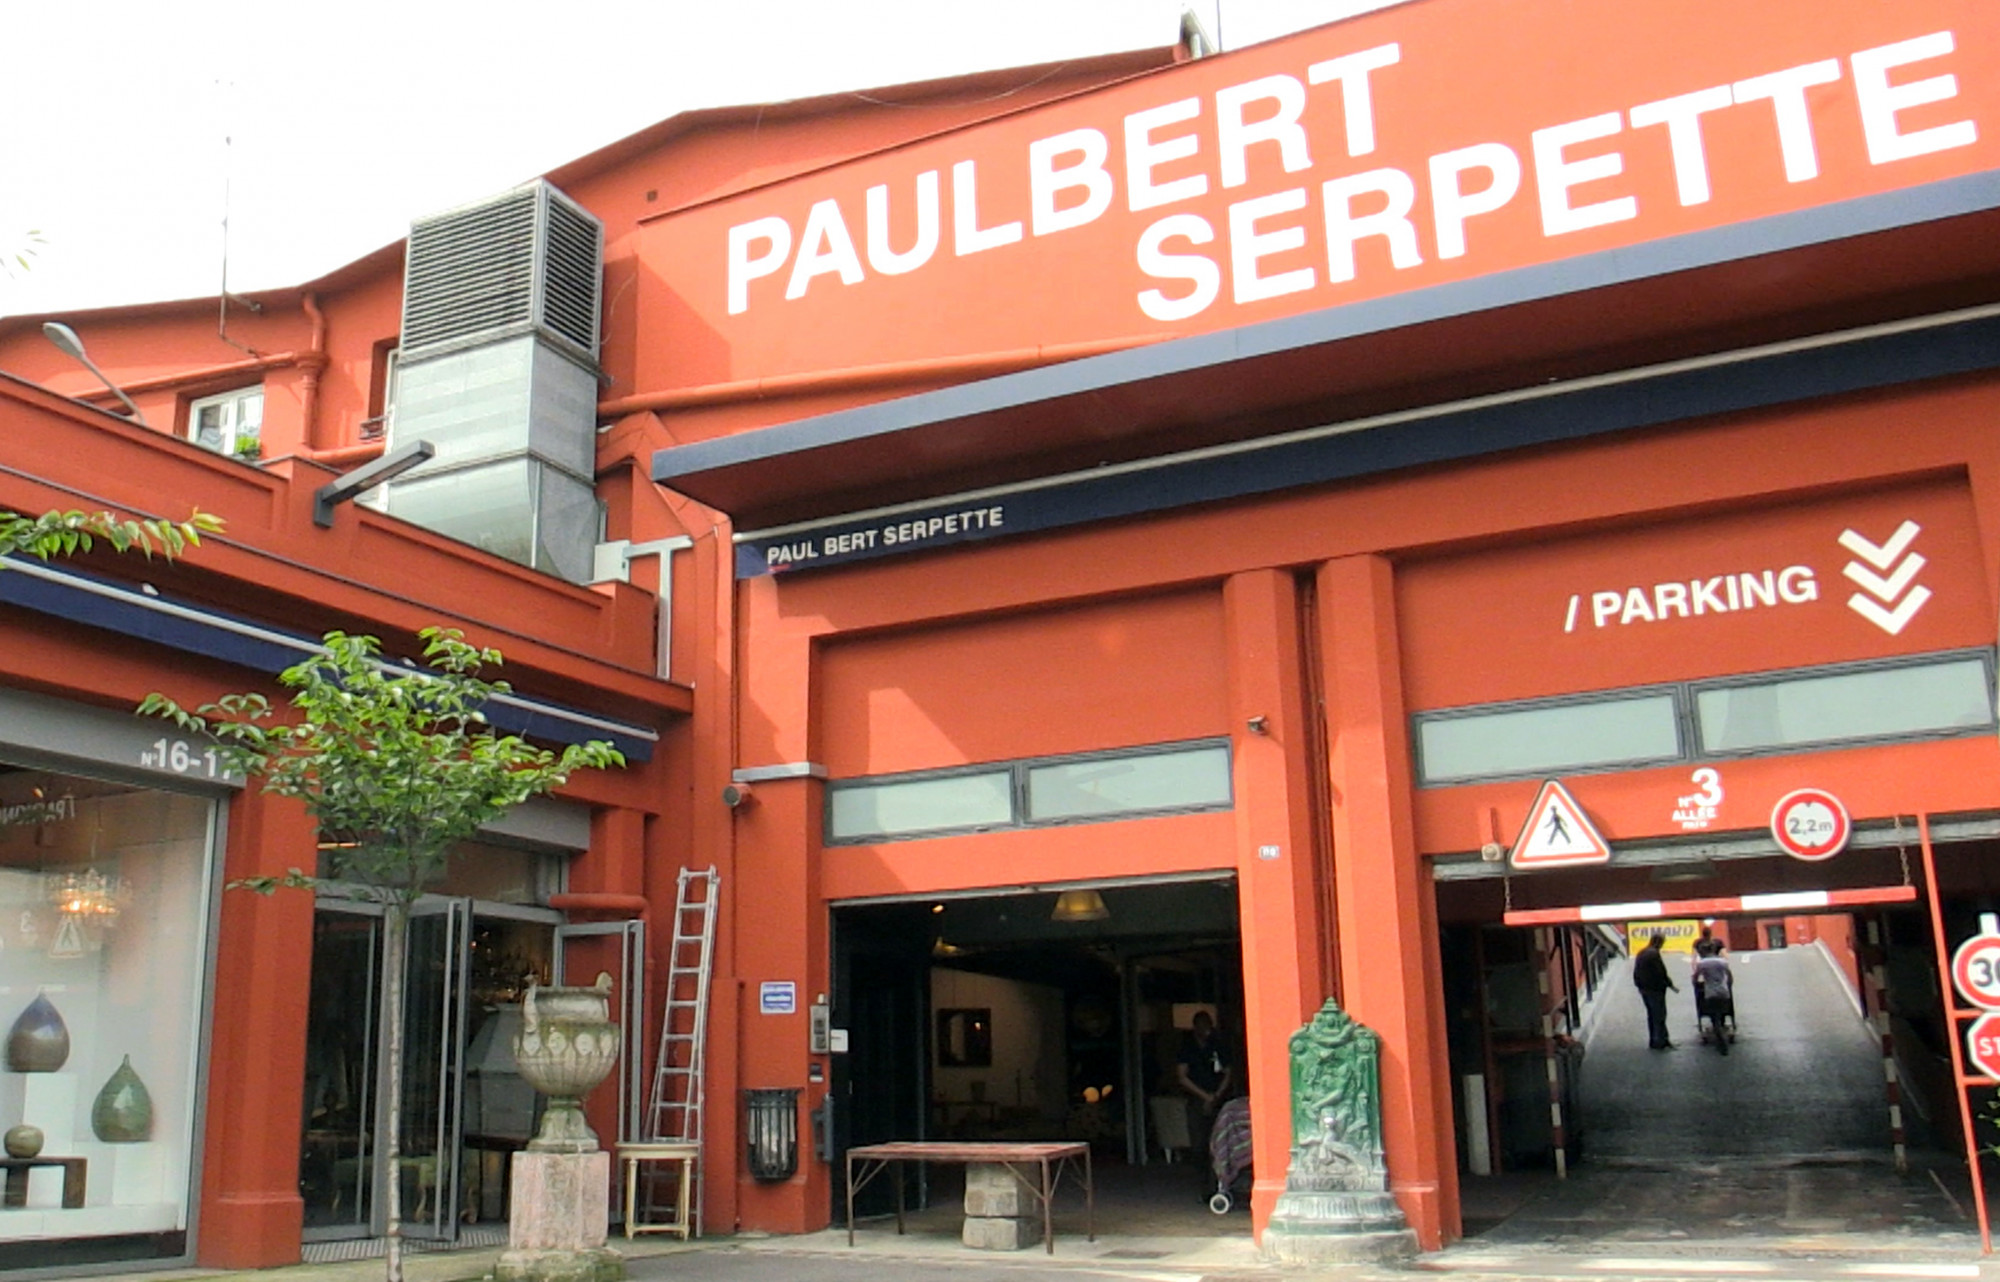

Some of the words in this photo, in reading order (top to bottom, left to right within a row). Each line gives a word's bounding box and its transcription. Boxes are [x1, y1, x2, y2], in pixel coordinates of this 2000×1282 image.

[1136, 29, 1979, 322] SERPETTE
[767, 541, 818, 565] PAUL
[825, 530, 879, 555] BERT
[884, 506, 1003, 545] SERPETTE
[1592, 565, 1818, 627] PARKING
